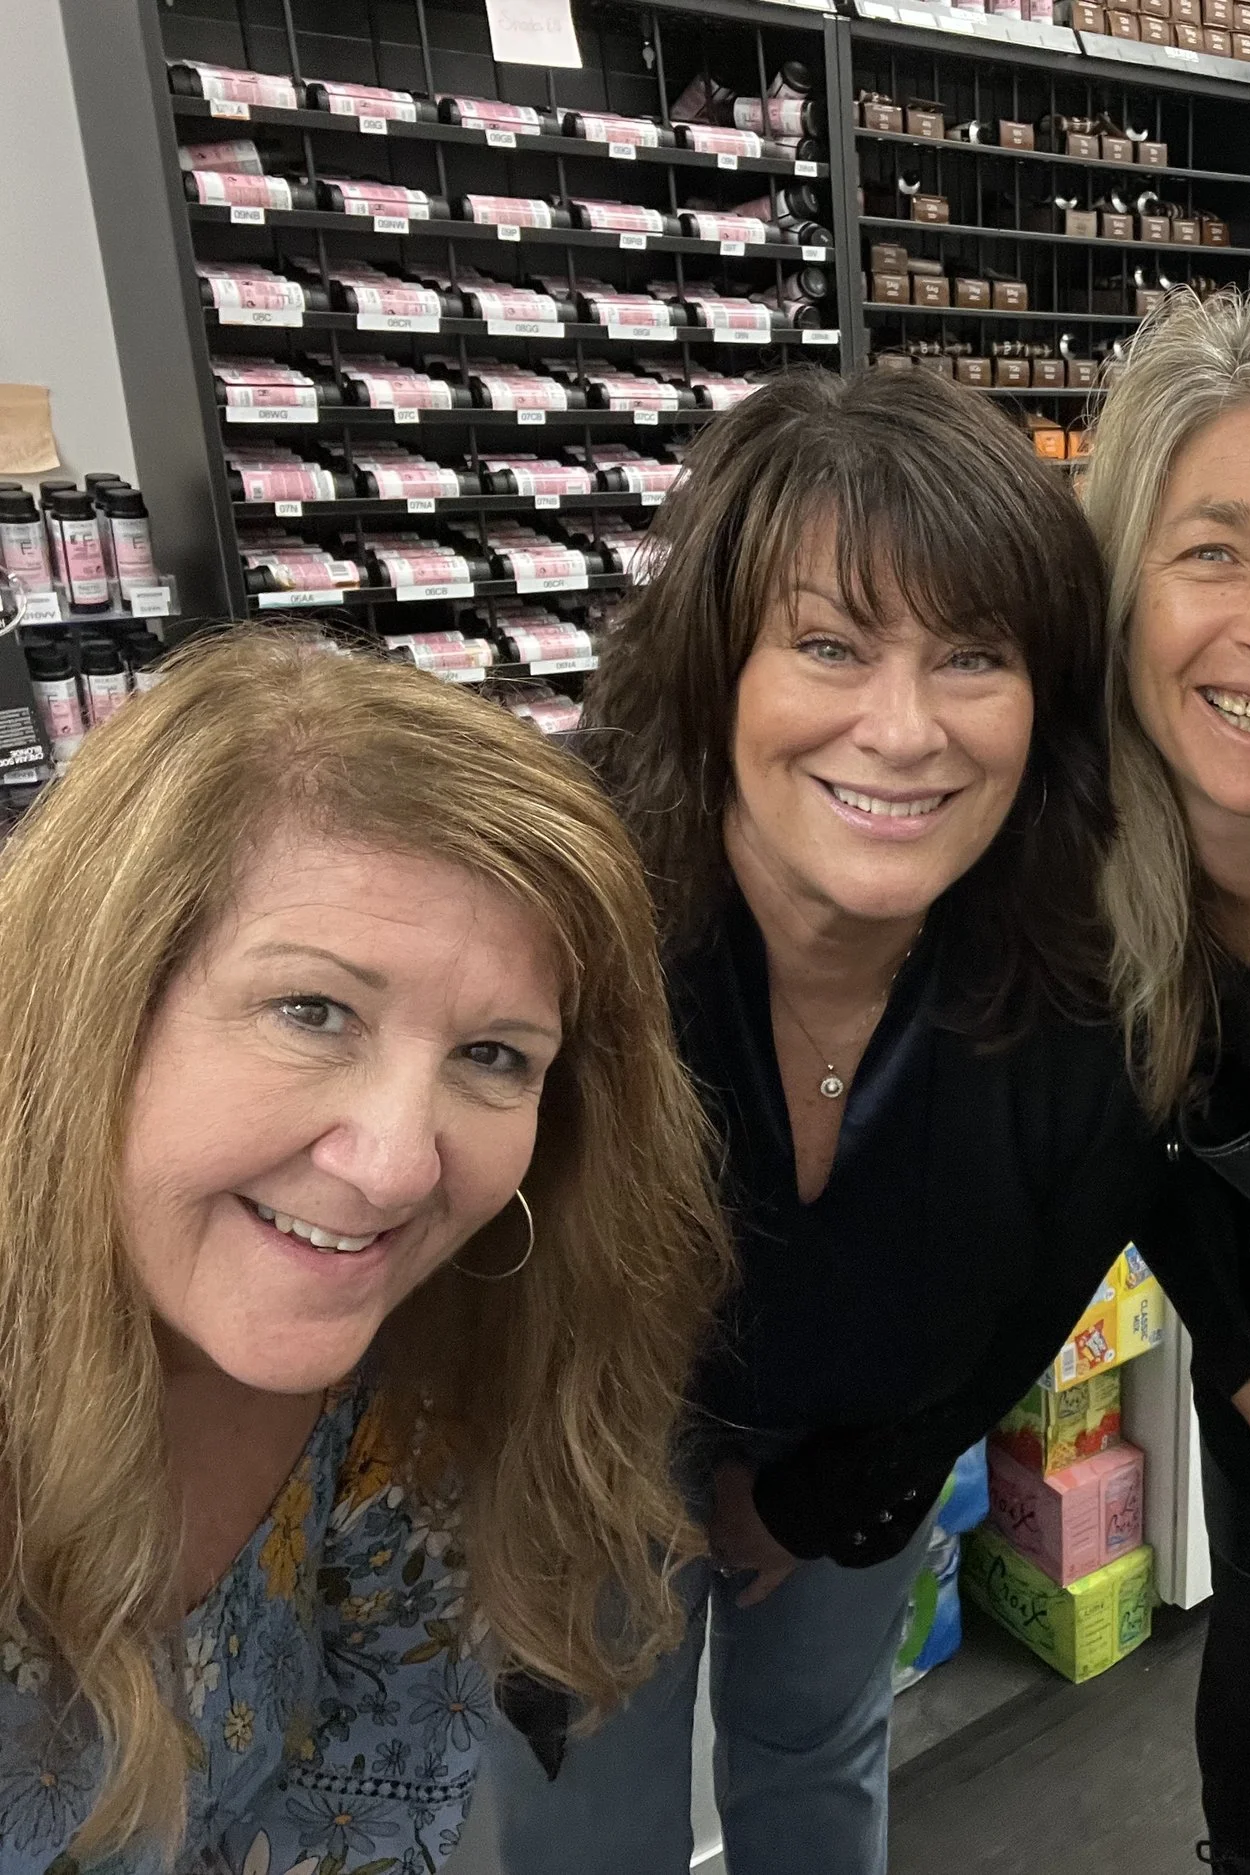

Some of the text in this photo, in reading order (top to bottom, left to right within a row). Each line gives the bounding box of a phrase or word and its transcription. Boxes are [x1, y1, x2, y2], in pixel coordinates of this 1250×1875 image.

[258, 410, 288, 419] 08WG
[279, 504, 299, 513] 07N
[9, 745, 43, 757] BLONDE
[1140, 1299, 1149, 1341] CLASSIC
